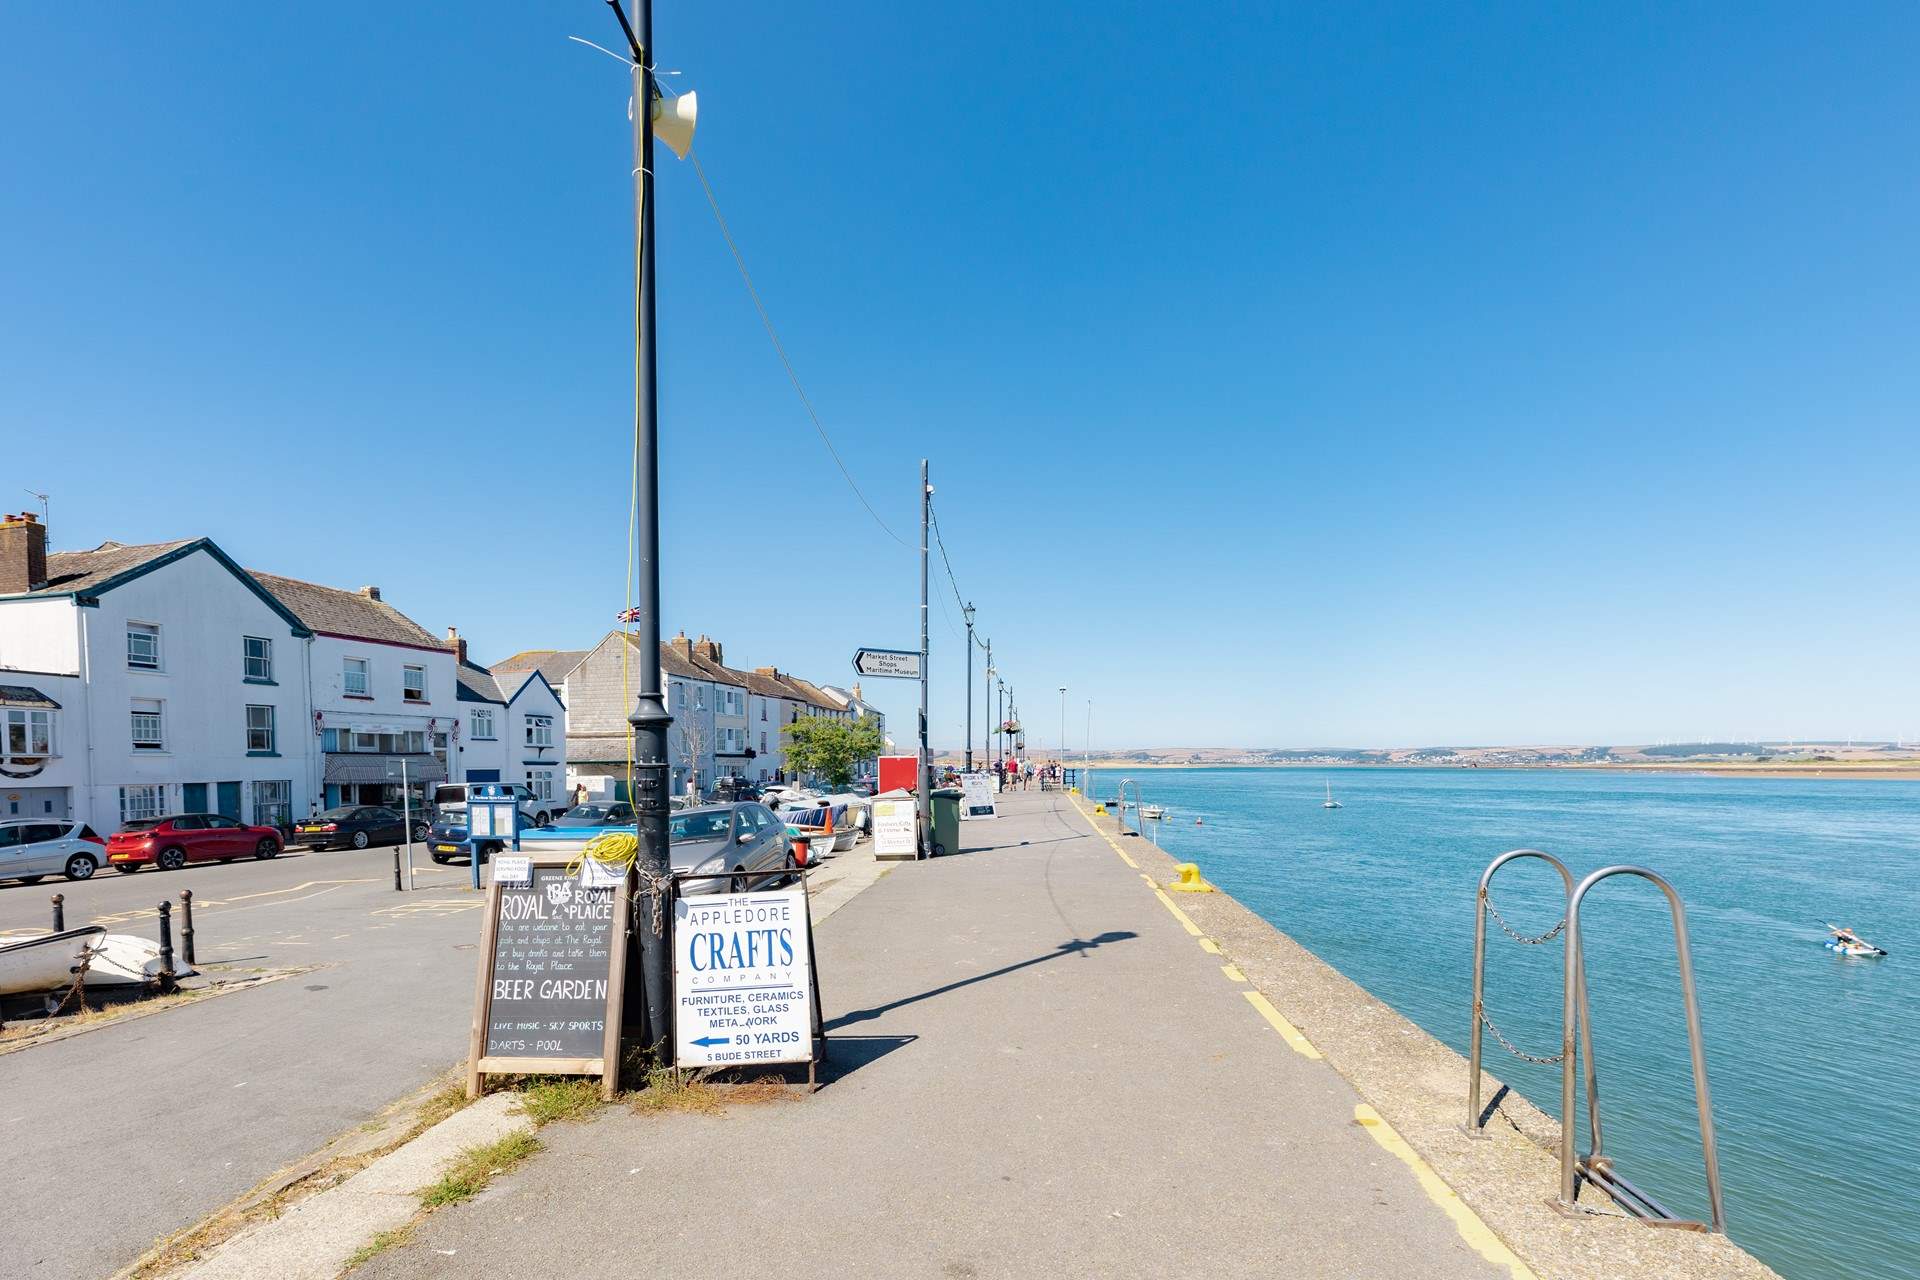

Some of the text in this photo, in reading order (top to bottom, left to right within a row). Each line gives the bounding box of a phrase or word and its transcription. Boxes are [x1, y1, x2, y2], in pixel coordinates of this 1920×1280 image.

[574, 889, 614, 904] ROYAL
[728, 897, 749, 907] THE
[500, 894, 548, 920] ROYAL
[569, 904, 613, 920] PLAICE
[690, 906, 790, 926] APPLEDORE
[502, 920, 514, 931] You
[532, 920, 559, 931] welcome
[561, 922, 570, 931] to
[574, 921, 586, 931] eat
[592, 924, 608, 934] your
[517, 935, 529, 944] and
[532, 935, 551, 946] chips
[554, 935, 563, 944] at
[565, 934, 579, 944] The
[583, 934, 602, 947] Royal
[512, 947, 525, 960] buy
[527, 949, 549, 958] drinks
[567, 948, 584, 957] take
[589, 948, 607, 957] them
[689, 927, 794, 972] CRAFTS
[496, 961, 505, 970] to
[507, 961, 520, 970] the
[525, 960, 545, 975] Royal
[692, 971, 792, 985] COMPANY
[493, 979, 608, 1000] BEER GARDEN
[681, 990, 804, 1006] FURNITURE, CERAMICS
[697, 1003, 790, 1017] TEXTILES, GLASS
[493, 1022, 513, 1030] LIVE
[516, 1021, 541, 1030] MUSIC
[548, 1021, 566, 1031] SKY
[567, 1020, 604, 1031] SPORTS
[735, 1031, 800, 1045] 50 YARDS
[490, 1040, 526, 1050] DARTS
[536, 1040, 563, 1051] POOL
[707, 1049, 782, 1062] 5 BUDE STREET
